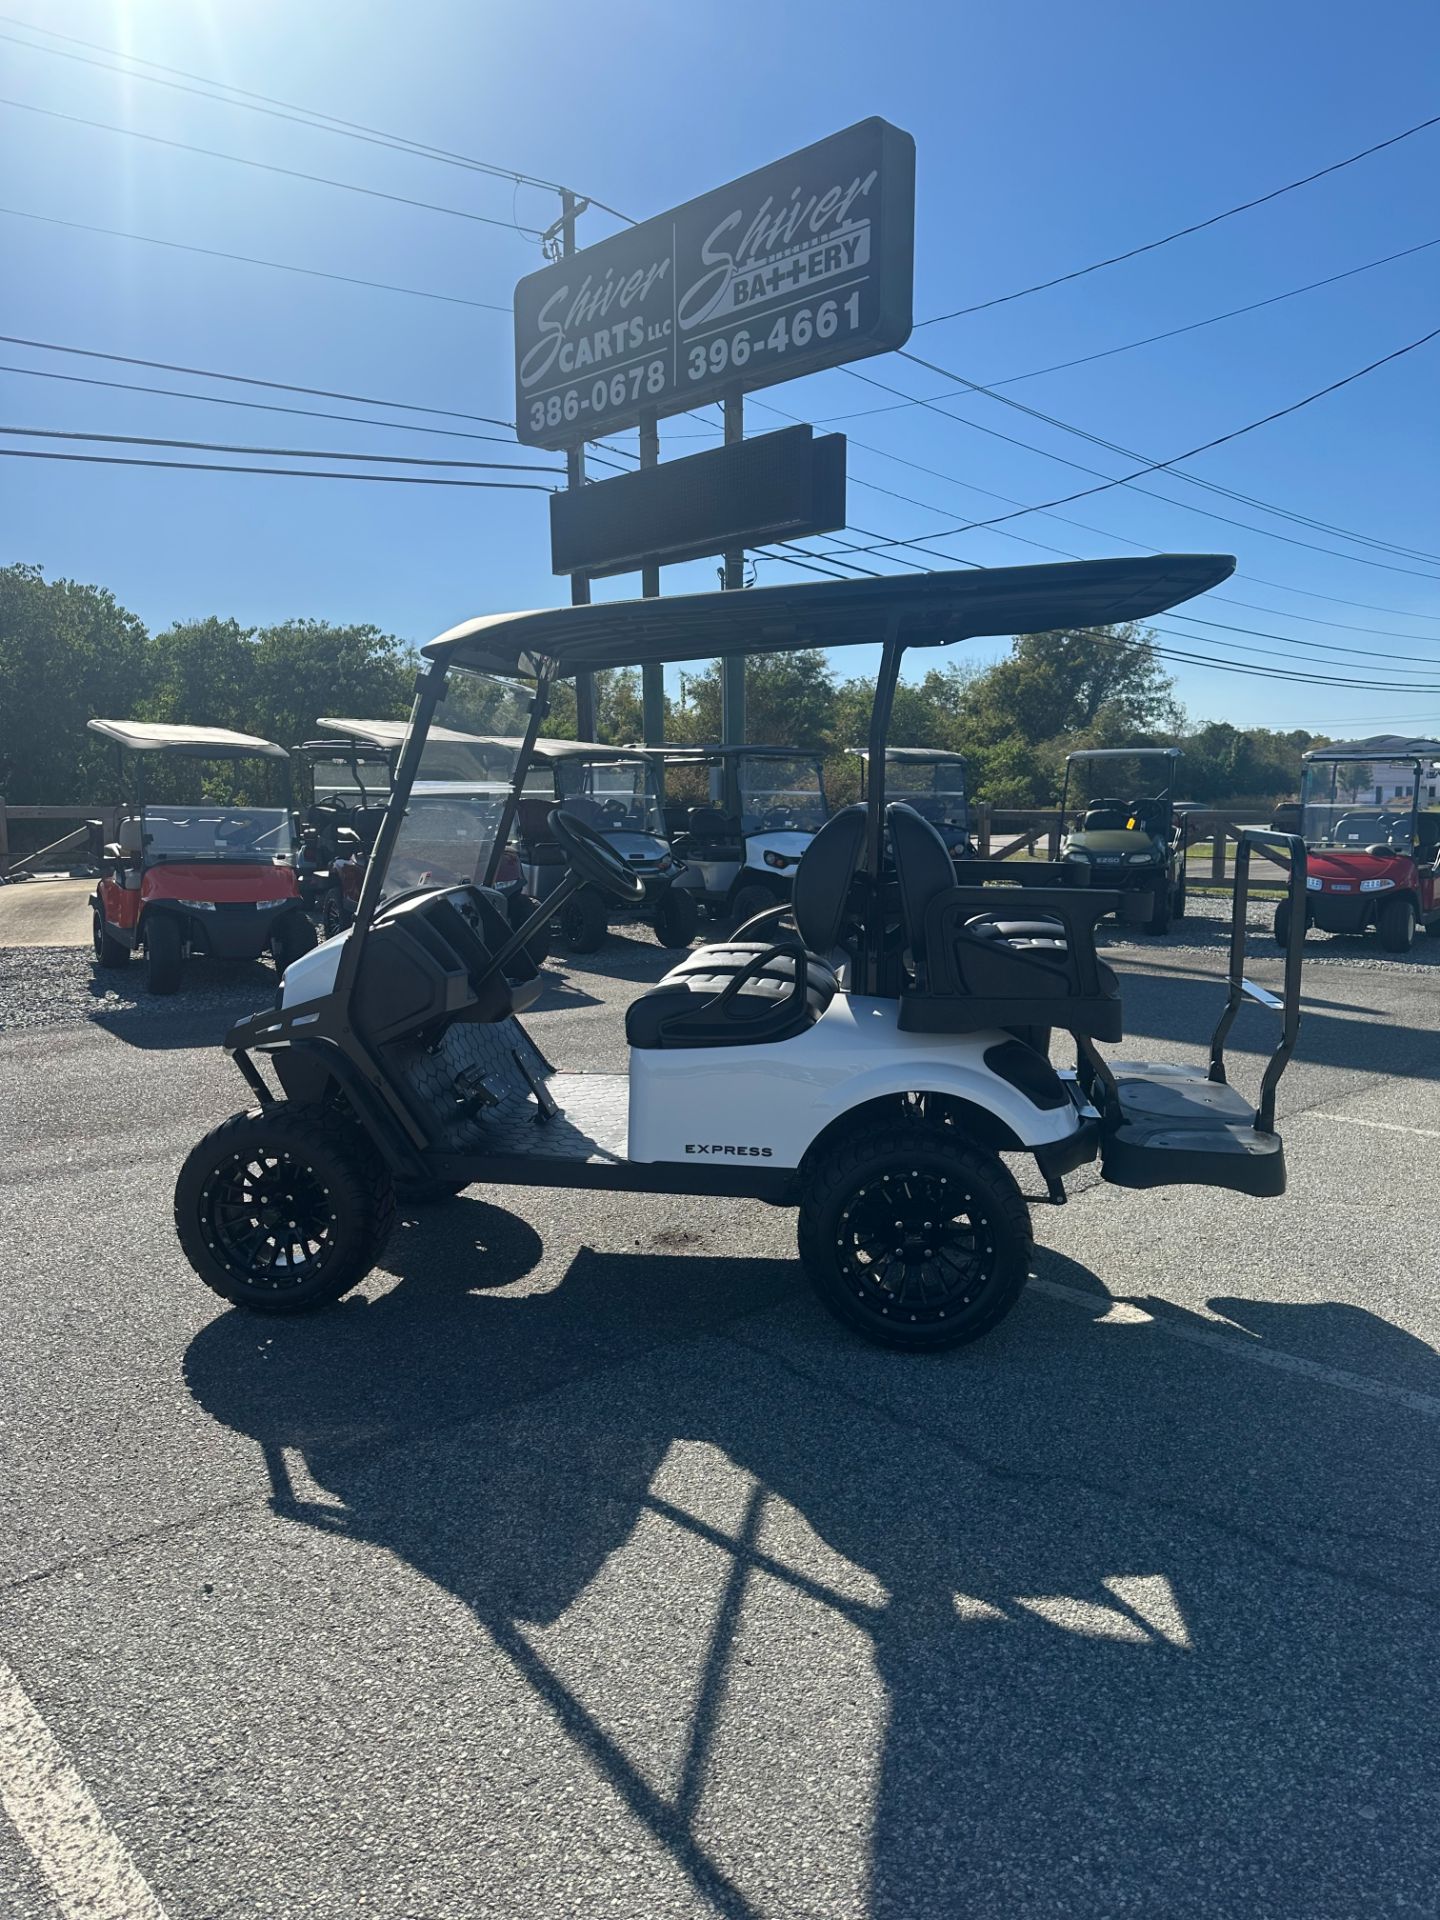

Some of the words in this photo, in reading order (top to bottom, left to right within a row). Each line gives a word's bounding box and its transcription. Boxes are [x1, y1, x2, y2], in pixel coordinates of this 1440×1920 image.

[677, 170, 877, 330] Shiver
[520, 258, 671, 388] Shiver
[558, 316, 645, 373] CARTS
[647, 319, 672, 341] LLC
[688, 291, 859, 380] 396-4661
[530, 360, 665, 431] 386-0678
[685, 1144, 773, 1157] EXPRESS
